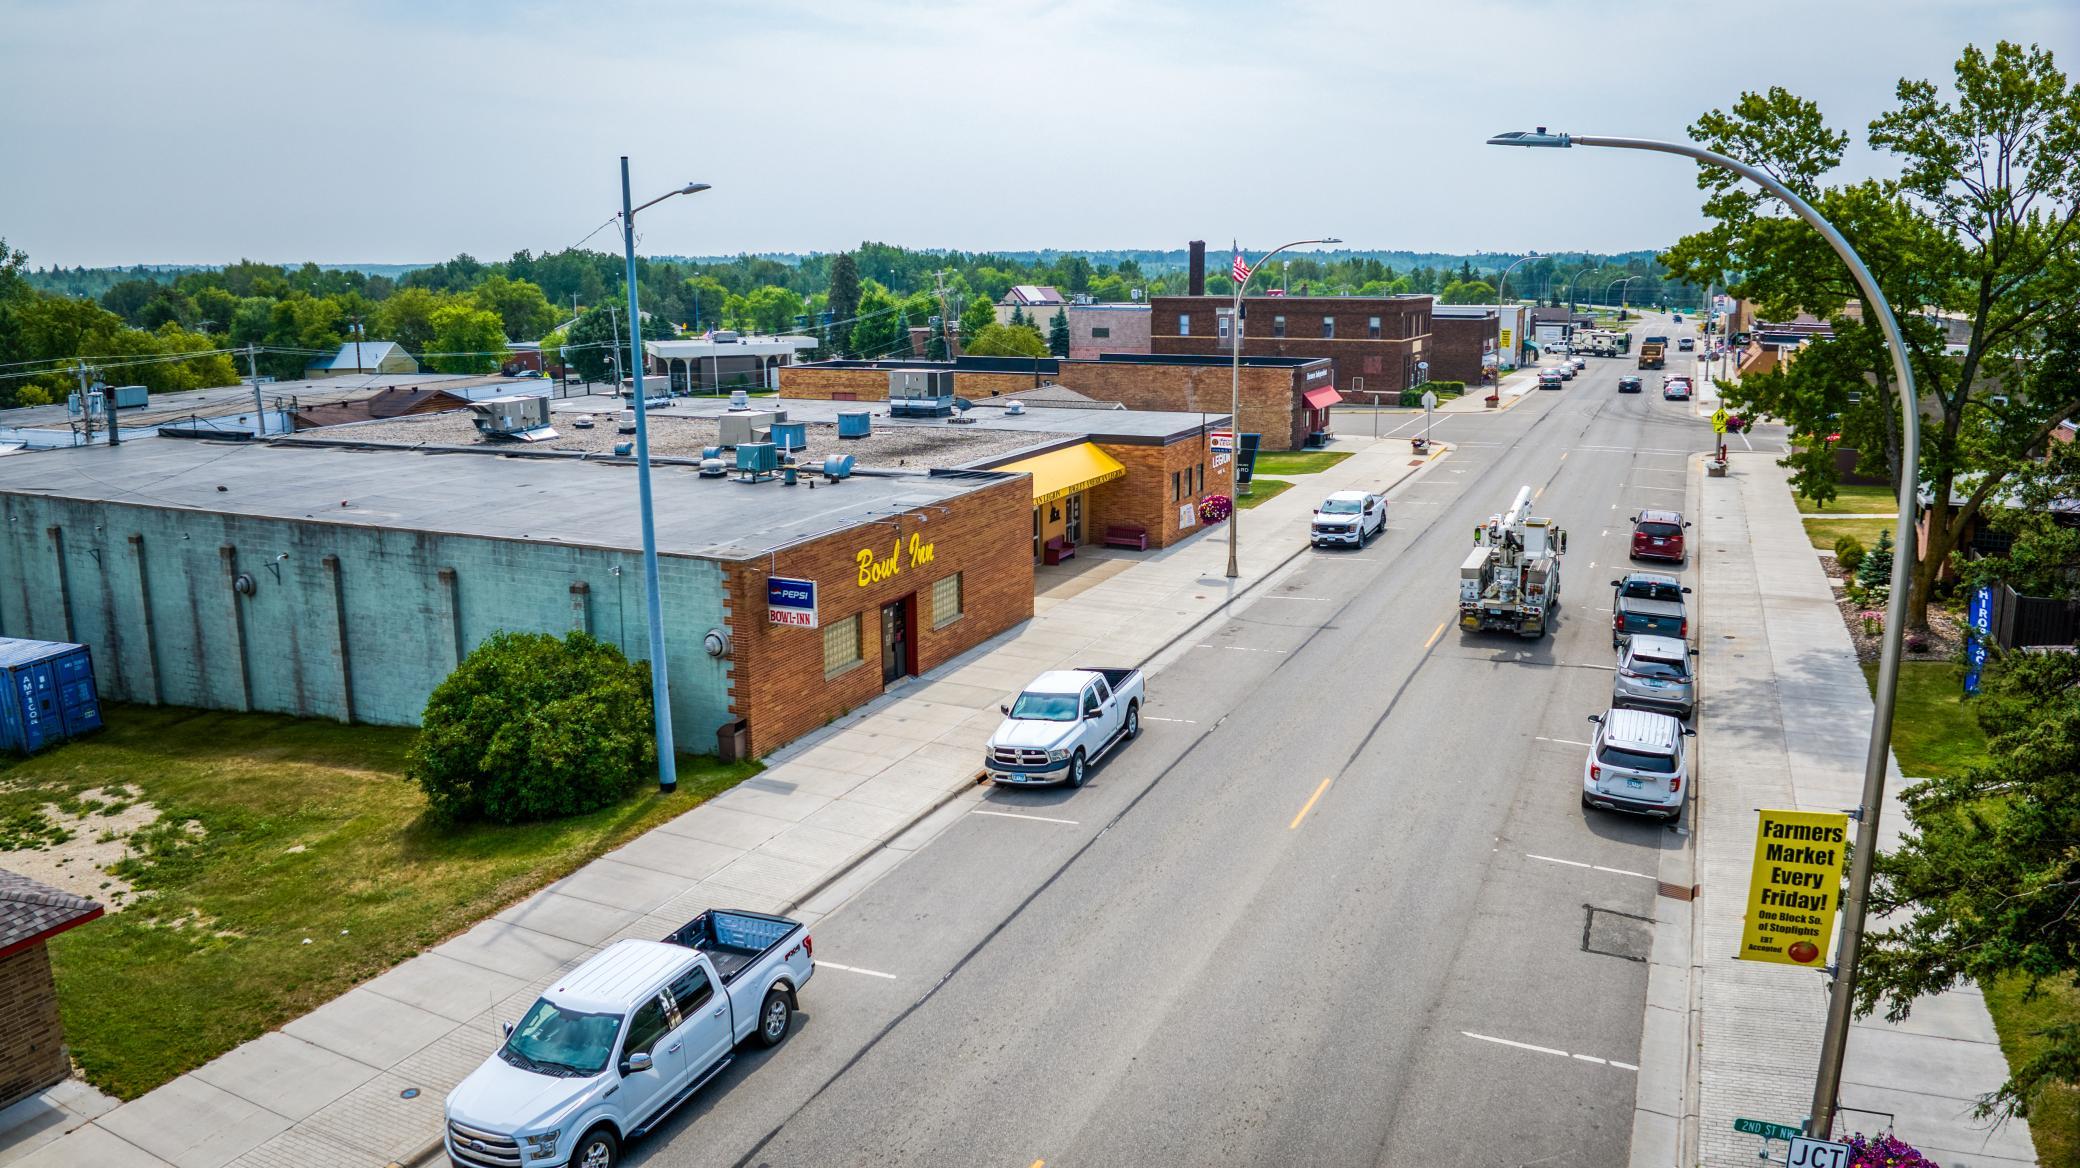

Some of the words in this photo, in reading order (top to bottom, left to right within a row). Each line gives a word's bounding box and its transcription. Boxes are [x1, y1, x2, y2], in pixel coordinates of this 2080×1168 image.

[856, 538, 900, 587] Bowl
[909, 532, 935, 569] Inn
[782, 590, 809, 600] PEPSI
[770, 610, 811, 625] BOWL-INN
[1763, 820, 1843, 843] Farmers
[1765, 843, 1835, 866] Market
[1771, 866, 1824, 889] Every
[1760, 888, 1828, 911] Friday!
[1758, 910, 1778, 920] One
[1779, 912, 1807, 924] Block
[1808, 915, 1823, 925] So.
[1758, 923, 1770, 931] of
[1769, 923, 1820, 937] Stoplights
[1748, 944, 1783, 953] Accepted
[1742, 1121, 1760, 1132] 2ND
[1765, 1124, 1777, 1136] ST
[1780, 1127, 1796, 1140] NW
[1792, 1144, 1844, 1168] JCT
